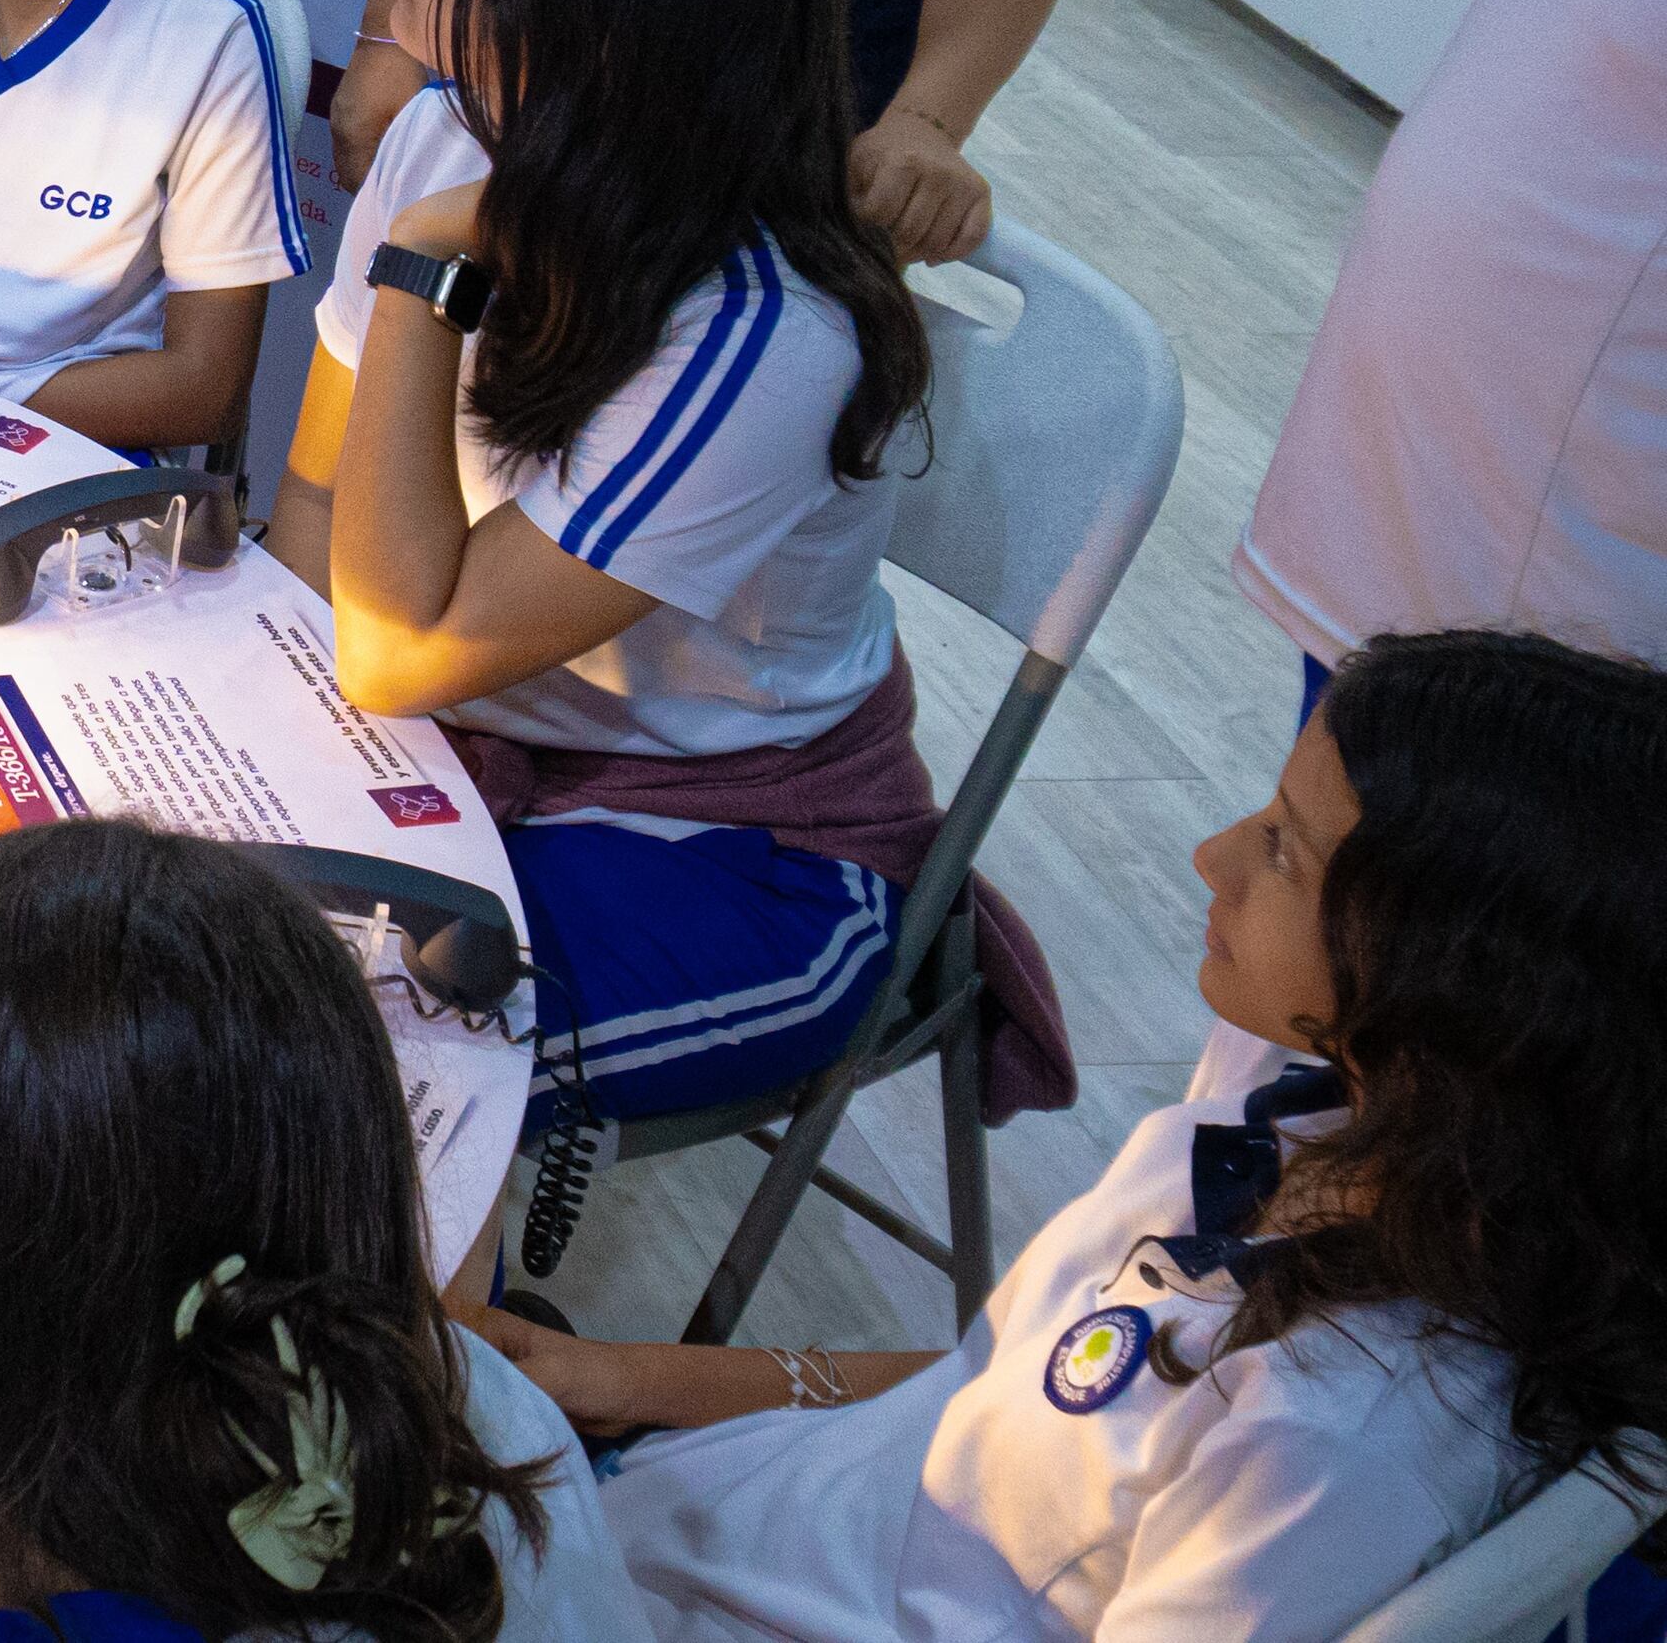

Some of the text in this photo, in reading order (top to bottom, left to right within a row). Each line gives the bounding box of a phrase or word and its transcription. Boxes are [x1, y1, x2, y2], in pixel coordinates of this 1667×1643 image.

[40, 184, 113, 220] GCB
[256, 613, 389, 780] Levanta bocina, oprime botón
